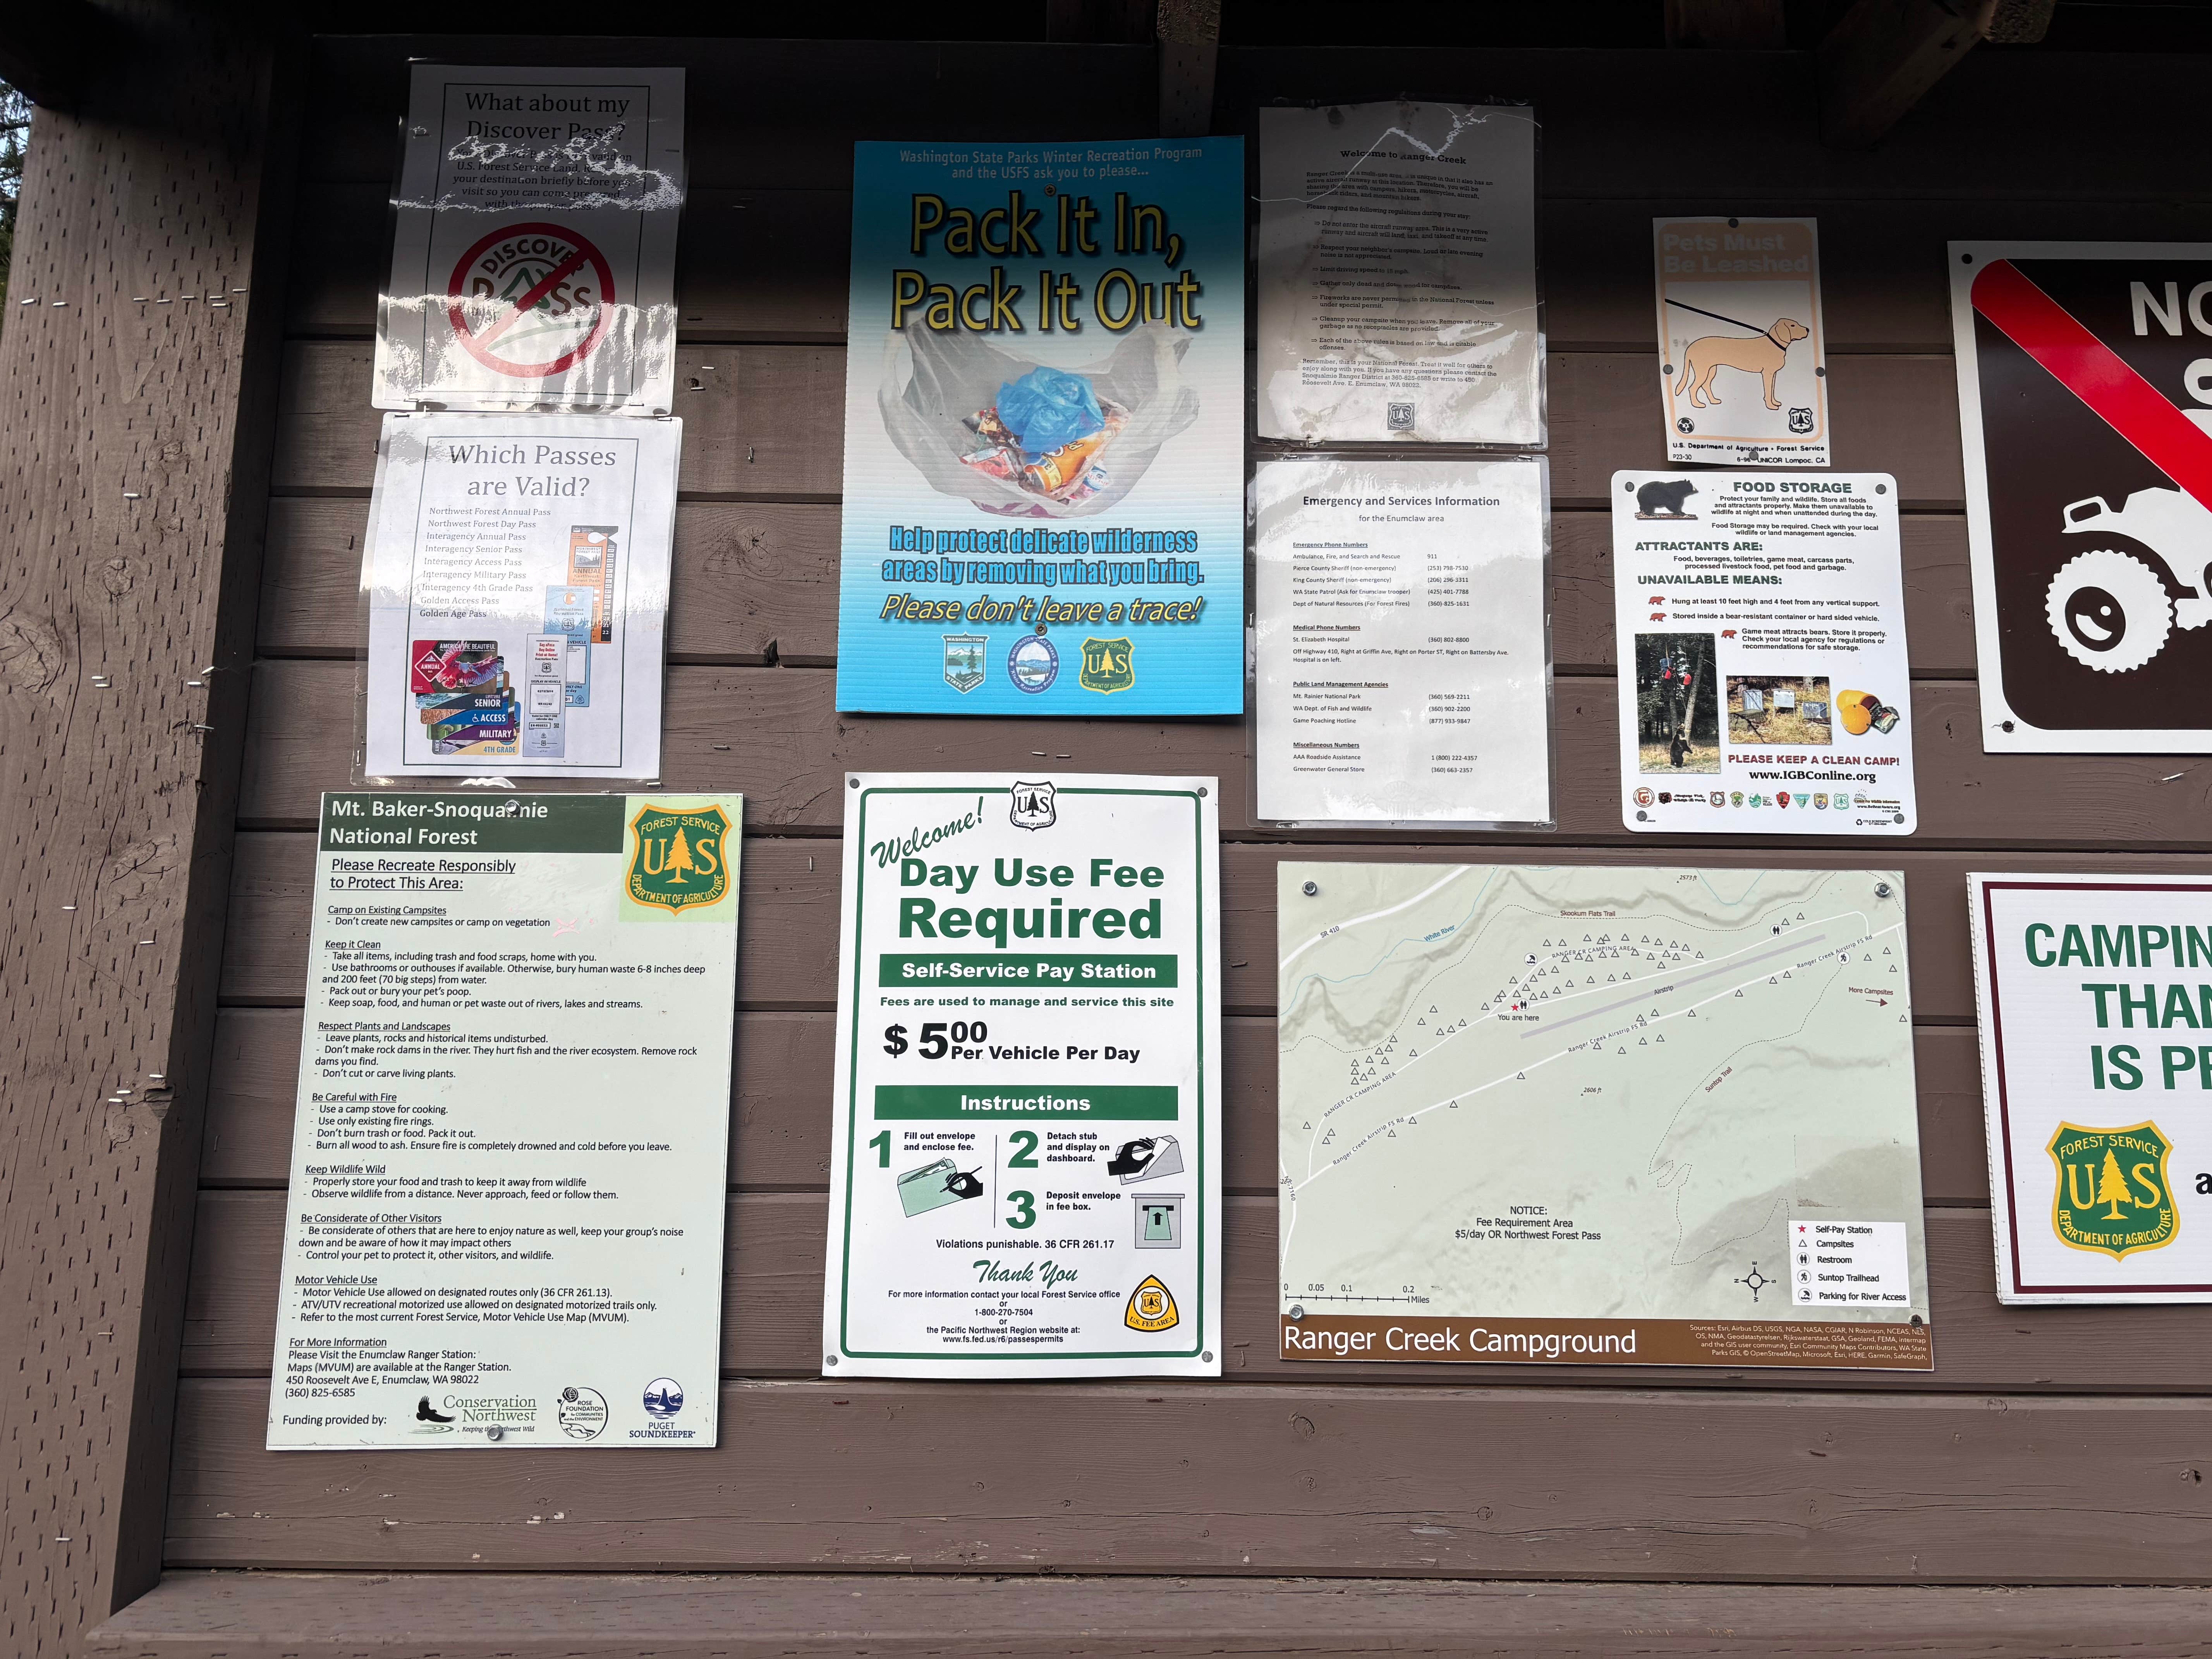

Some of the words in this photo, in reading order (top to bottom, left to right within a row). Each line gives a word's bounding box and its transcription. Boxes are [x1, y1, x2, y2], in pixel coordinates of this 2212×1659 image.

[465, 93, 524, 111] What
[529, 93, 592, 112] about
[597, 100, 630, 118] my
[467, 120, 561, 139] Discover
[900, 149, 968, 166] Washington
[972, 151, 1003, 163] State
[1008, 150, 1038, 163] Parks
[1043, 150, 1083, 163] Winter
[1087, 148, 1149, 161] Recreation
[1154, 147, 1202, 162] Program
[452, 175, 477, 184] your
[480, 175, 537, 184] destination
[541, 175, 574, 186] briefly
[577, 176, 610, 186] before
[910, 190, 1040, 254] Pack
[1057, 194, 1097, 254] It
[1114, 192, 1182, 267] In,
[1663, 234, 1717, 251] Pets
[1723, 234, 1785, 251] Must
[1664, 256, 1696, 273] Be
[1702, 255, 1809, 273] Leashed
[891, 266, 1022, 331] Pack
[1039, 270, 1079, 332] It
[1095, 267, 1201, 331] Out
[448, 444, 526, 464] Which
[534, 445, 616, 465] Passes
[467, 481, 507, 495] are
[515, 476, 590, 496] Valid?
[1733, 482, 1775, 492] FOOD
[1779, 482, 1852, 493] STORAGE
[1303, 496, 1362, 508] Emergency
[1365, 496, 1385, 505] and
[1388, 496, 1432, 505] Services
[1435, 496, 1500, 506] Information
[890, 526, 933, 554] Help
[936, 528, 1008, 555] protect
[1009, 528, 1089, 554] delicate
[1091, 528, 1198, 554] wilderness
[1635, 541, 1729, 551] ATTRACTANTS
[1733, 541, 1763, 551] ARE:
[420, 608, 448, 617] Golden
[450, 609, 466, 619] Age
[880, 593, 960, 620] Please
[966, 595, 1034, 622] don't
[1036, 595, 1101, 622] leave
[1106, 604, 1124, 622] a
[1129, 595, 1203, 622] trace!
[474, 699, 501, 707] SENIOR
[480, 714, 506, 722] ACCESS
[479, 730, 512, 738] MILITARY
[1728, 754, 1773, 764] PLEASE
[1776, 755, 1807, 764] KEEP
[1810, 756, 1819, 764] A
[1822, 756, 1860, 765] CLEAN
[1864, 756, 1899, 766] CAMP!
[1748, 770, 1876, 784] www.IGBConline.org
[333, 801, 364, 816] Mt.
[373, 799, 548, 821] Baker-Snoquamie
[330, 827, 412, 844] National
[418, 829, 478, 845] Forest
[871, 796, 984, 868] Welcome!
[331, 858, 374, 872] Please
[378, 859, 435, 872] Recreate
[438, 859, 516, 874] Responsibly
[901, 858, 979, 894] Day
[995, 858, 1074, 886] Use
[1091, 859, 1164, 887] Fee
[899, 898, 1161, 948] Required
[1329, 926, 1340, 935] 410
[1424, 932, 1441, 942] White
[1441, 924, 1455, 935] River
[902, 962, 1029, 978] Self-Service
[1037, 963, 1075, 982] Pay
[1081, 963, 1156, 978] Station
[1654, 985, 1674, 995] Airstrip
[951, 1046, 984, 1060] Per
[988, 1046, 1060, 1060] Vehicle
[1066, 1046, 1099, 1060] Per
[1104, 1046, 1140, 1063] Day
[2091, 1045, 2143, 1090] IS
[961, 1095, 1091, 1111] Instructions
[904, 1132, 917, 1140] Fill
[936, 1132, 975, 1141] envelope
[2060, 1135, 2104, 1159] FOREST
[2109, 1135, 2159, 1158] SERVICE
[1510, 1206, 1547, 1215] NOTICE:
[1815, 1225, 1845, 1235] Self-Pay
[2059, 1210, 2110, 1245] DEPARTMENT
[2112, 1234, 2124, 1245] OF
[2126, 1208, 2171, 1245] AGRICULTURE
[936, 1239, 983, 1249] Violations
[986, 1239, 1042, 1251] punishable.
[1045, 1240, 1056, 1249] 36
[1059, 1239, 1080, 1249] CFR
[1083, 1240, 1115, 1249] 261.17
[1816, 1240, 1854, 1249] Campsites
[973, 1260, 1034, 1283] Thank
[1039, 1260, 1078, 1289] You
[943, 1335, 1063, 1345] www.fs.fed.us/r6/passespermits
[1285, 1326, 1376, 1355] Ranger
[1386, 1327, 1460, 1351] Creek
[1470, 1329, 1635, 1358] Campground
[286, 1376, 304, 1384] 450
[306, 1375, 350, 1384] Roosevelt
[352, 1376, 369, 1384] Ave
[371, 1375, 379, 1386] E,
[382, 1374, 430, 1386] Enumclaw,
[432, 1375, 448, 1384] WA
[450, 1375, 479, 1384] 98022
[285, 1388, 309, 1399] (360)
[311, 1388, 355, 1397] 825-6585
[443, 1395, 538, 1411] Conservation
[462, 1408, 538, 1422] Northwest
